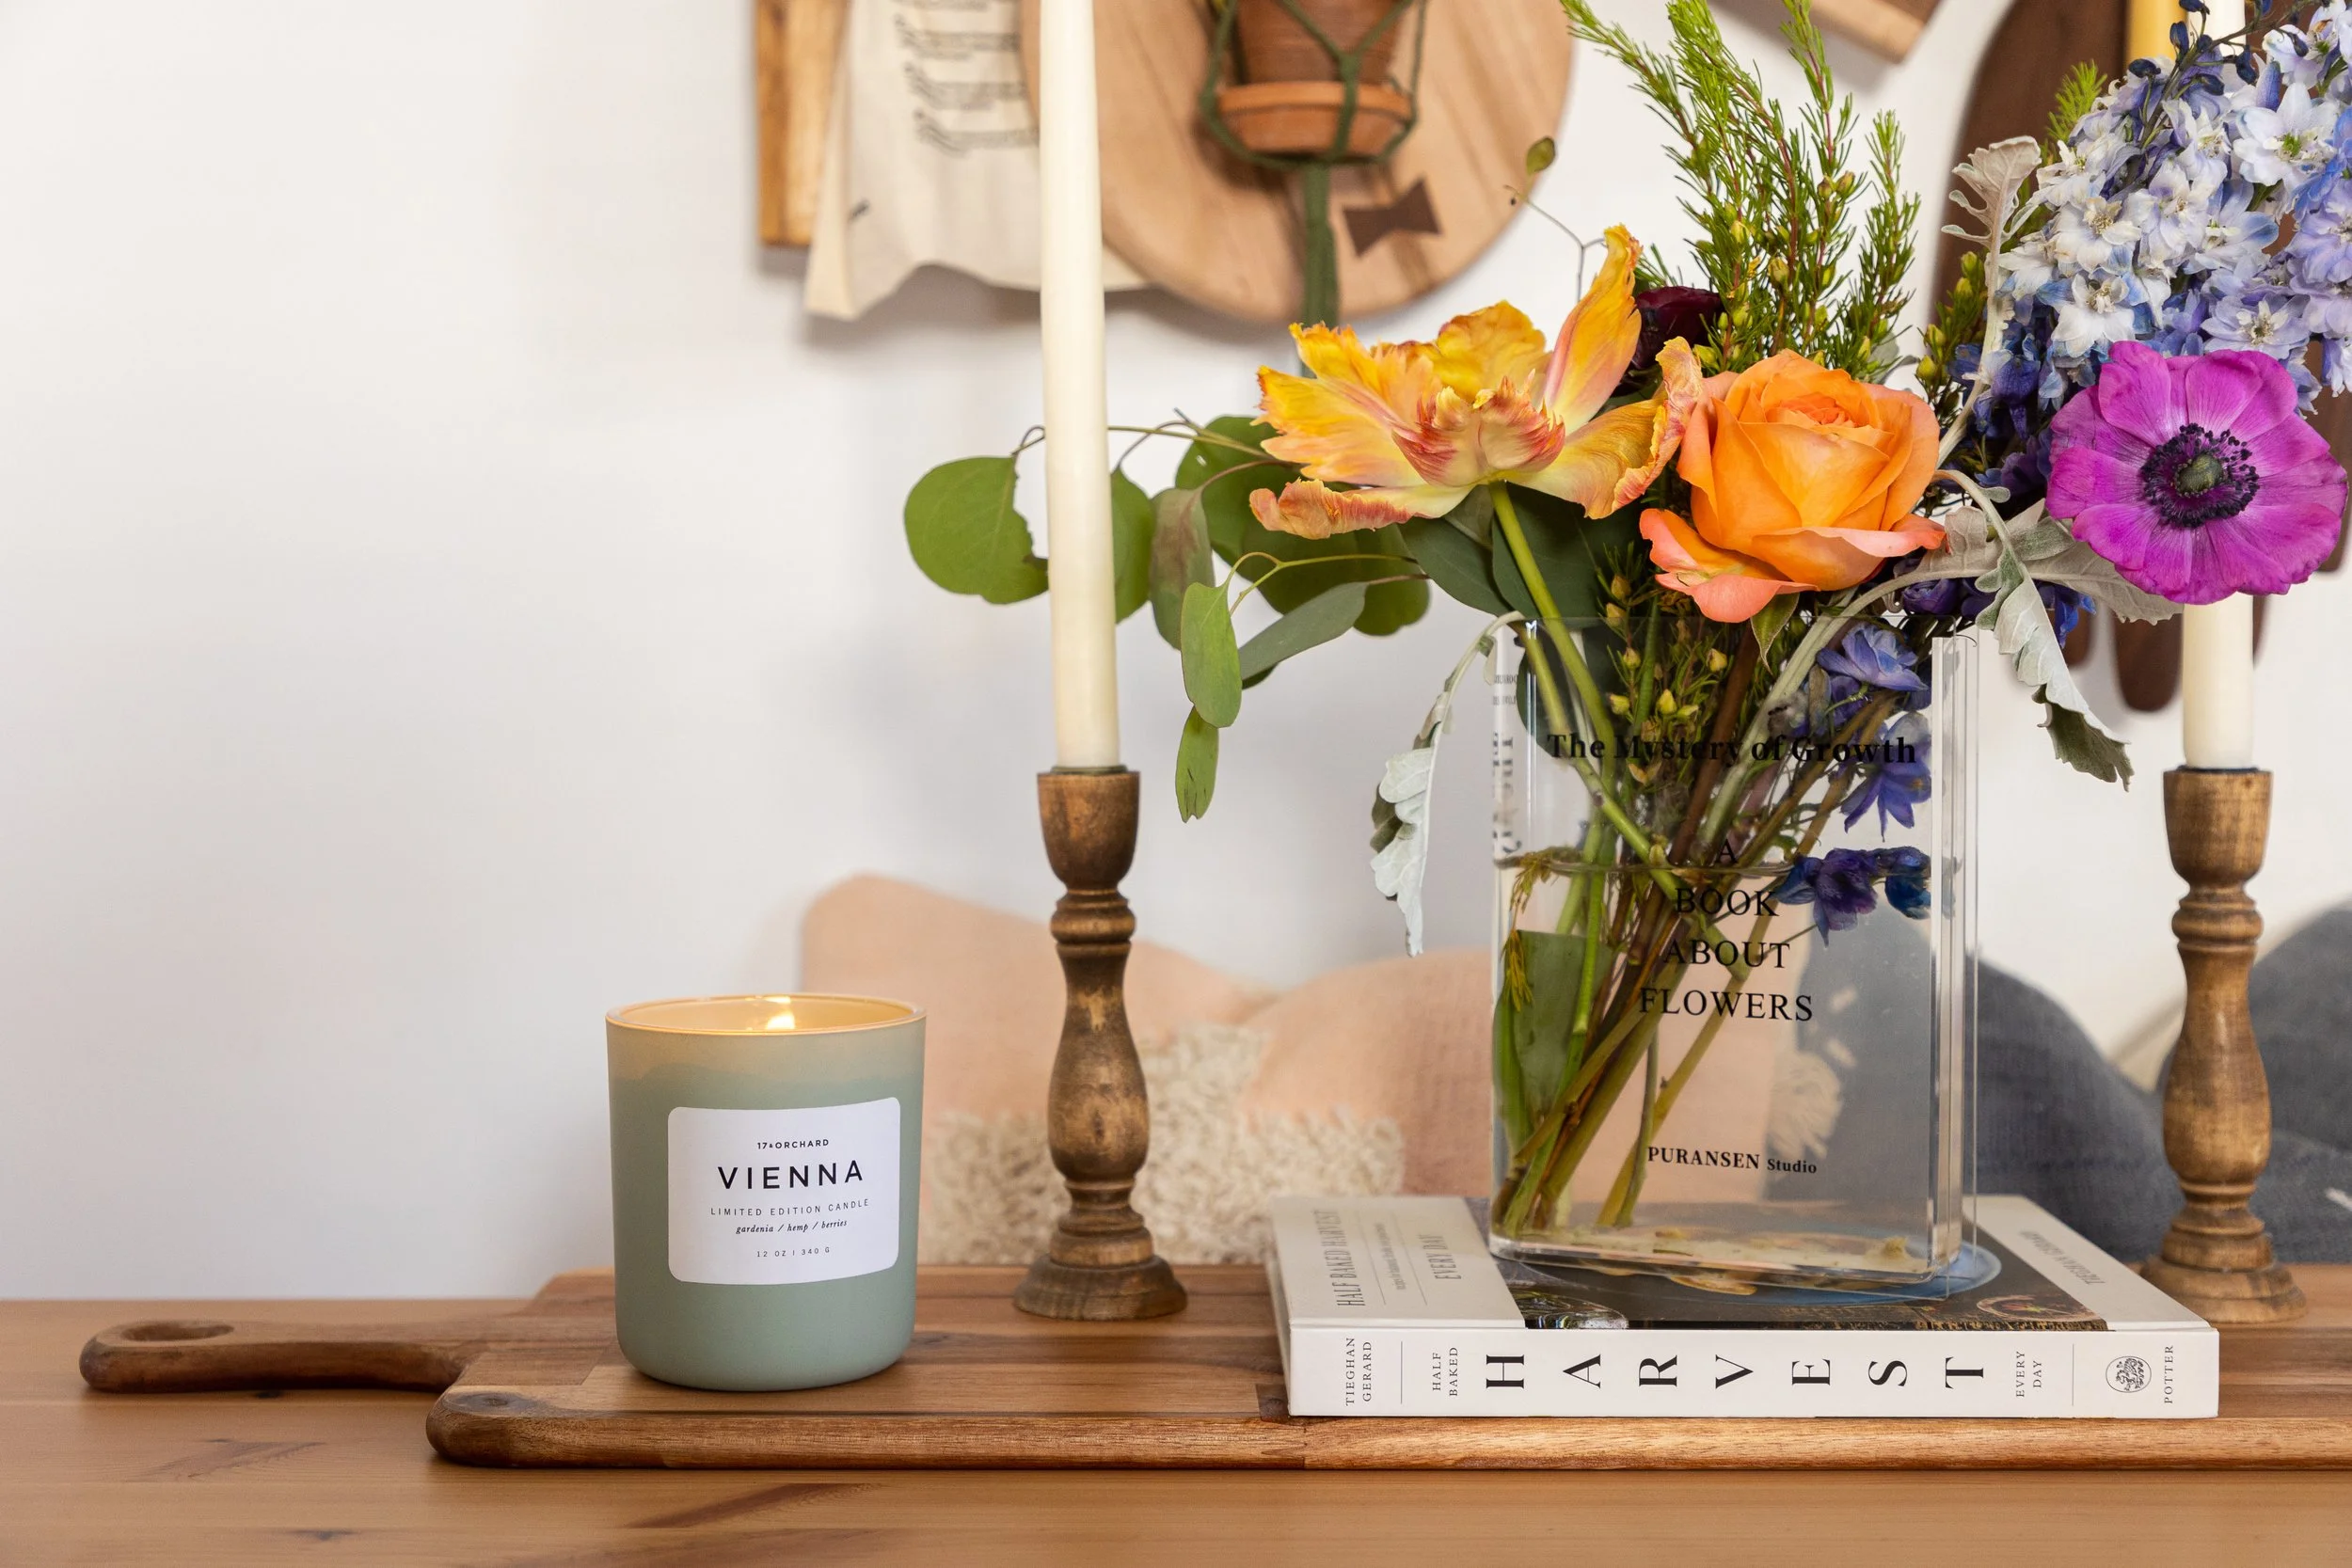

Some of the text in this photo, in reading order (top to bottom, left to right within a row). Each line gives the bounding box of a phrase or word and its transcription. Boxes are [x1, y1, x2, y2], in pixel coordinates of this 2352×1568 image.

[1547, 734, 1916, 768] The Mystery of Growth
[1715, 838, 1738, 864] A
[1676, 887, 1779, 917] BOOK
[1663, 938, 1790, 969] ABOUT
[1640, 988, 1813, 1022] FLOWERS
[718, 1160, 863, 1190] VIENNA
[1647, 1147, 1817, 1174] PURANSEN Studio
[710, 1198, 869, 1216] LIMITED EDITION CANDLE
[736, 1224, 774, 1235] gardenia
[787, 1224, 809, 1234] hemp
[821, 1219, 848, 1229] berries
[801, 1247, 819, 1256] 340
[1323, 1250, 1358, 1278] BAKED
[1425, 1252, 1462, 1279] EVERY
[1332, 1281, 1366, 1306] HALF
[1345, 1338, 1356, 1406] TIEGHAN
[1362, 1341, 1372, 1402] GERARD
[1432, 1352, 1441, 1391] HALF
[1449, 1347, 1458, 1397] BAKED
[1486, 1354, 1984, 1389] HARVEST
[2015, 1351, 2026, 1398] EVERY
[2033, 1360, 2042, 1388] DAY
[2164, 1345, 2174, 1404] POTTER
